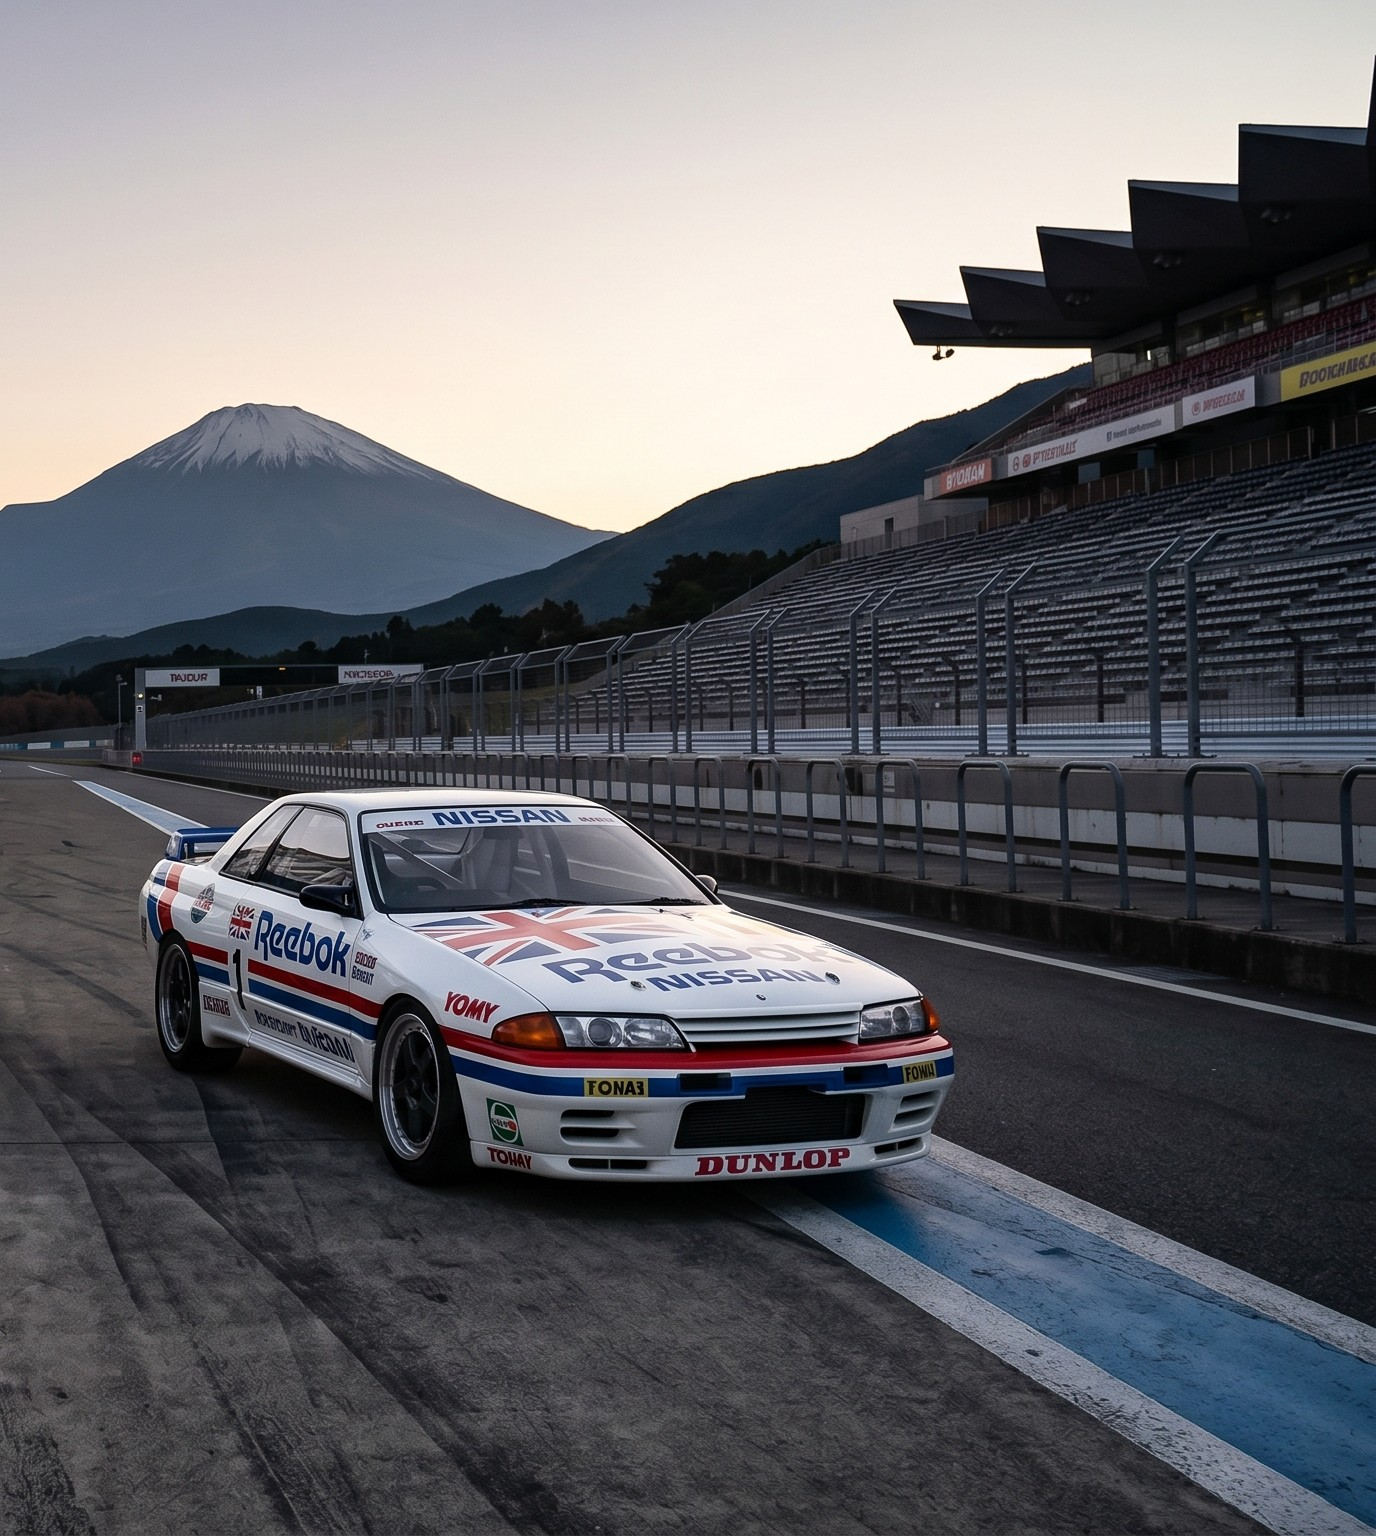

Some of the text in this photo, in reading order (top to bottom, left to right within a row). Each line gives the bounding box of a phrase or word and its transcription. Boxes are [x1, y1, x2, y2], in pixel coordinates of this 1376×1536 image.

[432, 810, 571, 826] NISSAN
[254, 910, 351, 978] Reebok
[233, 948, 247, 1011] 1
[541, 942, 854, 984] Reebok
[645, 968, 826, 992] NISSAN
[444, 991, 500, 1024] YOMY
[694, 1147, 851, 1176] DUNLOP
